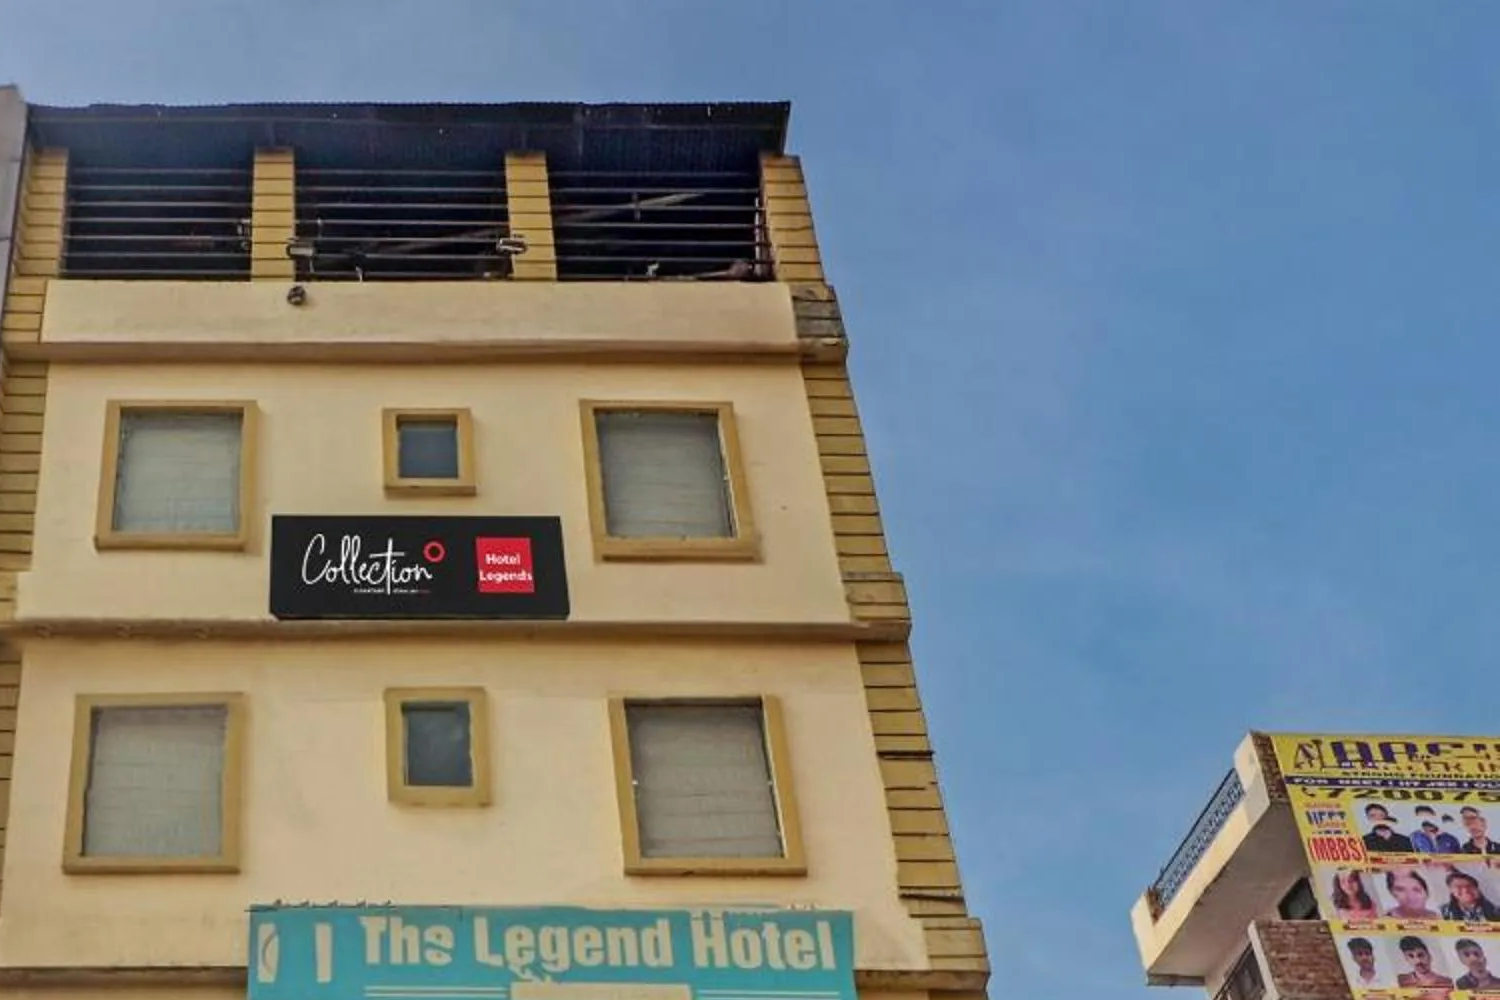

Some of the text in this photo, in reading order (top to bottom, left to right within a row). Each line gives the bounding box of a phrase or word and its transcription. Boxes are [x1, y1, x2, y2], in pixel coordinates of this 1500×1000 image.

[301, 533, 432, 595] Collection
[479, 569, 534, 583] Legends
[485, 553, 521, 565] Hotel
[473, 915, 674, 984] Legend
[690, 920, 837, 971] Hotel
